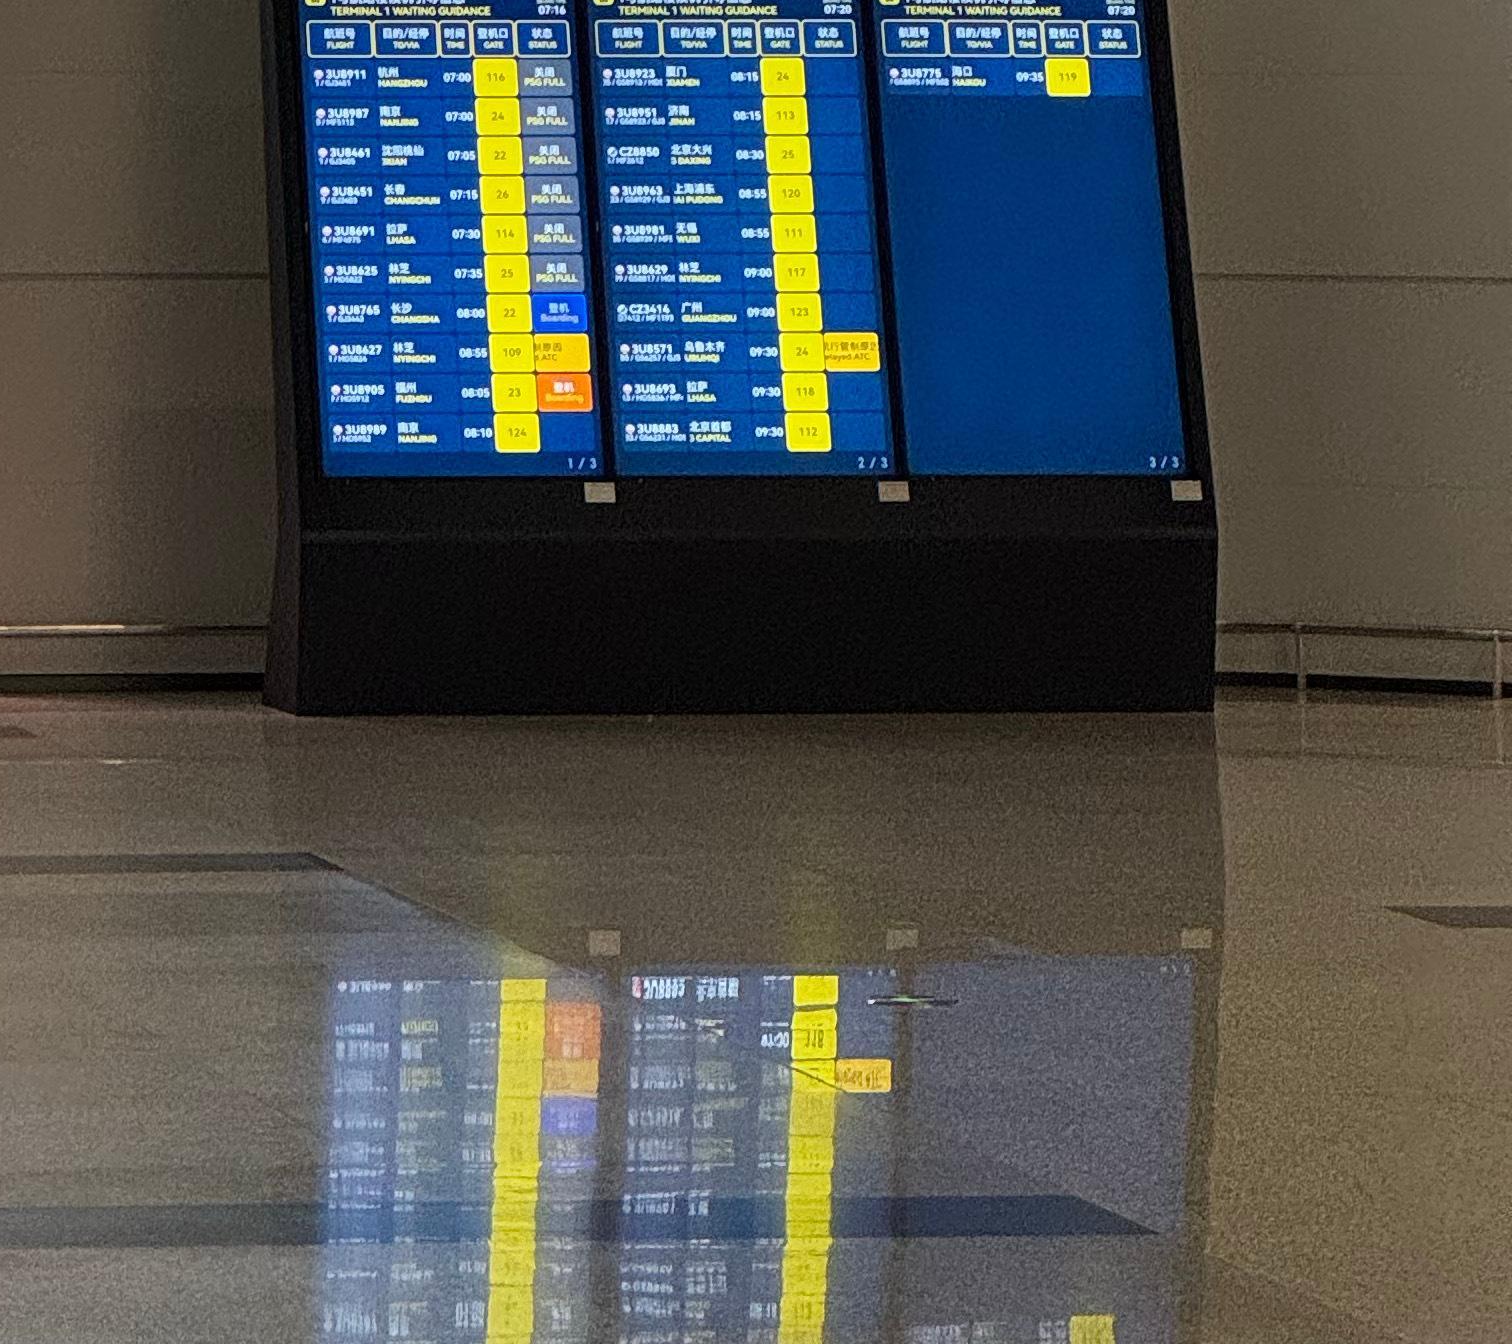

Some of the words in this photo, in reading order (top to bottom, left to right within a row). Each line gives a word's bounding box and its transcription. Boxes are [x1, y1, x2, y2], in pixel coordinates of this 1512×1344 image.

[330, 6, 382, 16] TERMINAL
[392, 6, 436, 16] WAITING
[438, 6, 491, 16] GUIDANCE
[538, 5, 566, 15] 07:16
[618, 6, 670, 15] TERMINAL
[679, 6, 723, 15] WAITING
[725, 6, 777, 15] GUIDANCE
[824, 5, 852, 15] 07:20
[904, 6, 955, 16] TERMINAL
[964, 6, 1008, 16] WAITING
[1009, 6, 1061, 16] GUIDANCE
[443, 72, 471, 83] 07:00
[487, 72, 505, 82] 116
[731, 72, 759, 82] 08:15
[1059, 72, 1077, 81] 119
[445, 111, 473, 122] 07:00
[733, 111, 761, 121] 08:15
[776, 111, 794, 120] 113
[448, 150, 476, 161] 07:05
[494, 151, 506, 160] 22
[736, 150, 764, 160] 08:30
[782, 150, 794, 159] 25
[450, 190, 478, 200] 07:15
[496, 190, 509, 199] 26
[738, 189, 767, 199] 08:55
[782, 189, 800, 198] 120
[452, 229, 480, 239] 07:30
[741, 228, 769, 238] 08:55
[784, 229, 802, 238] 111
[454, 268, 483, 279] 07:35
[501, 269, 513, 278] 25
[744, 268, 772, 278] 09:00
[787, 268, 806, 277] 117
[456, 308, 485, 318] 08:00
[503, 308, 516, 317] 22
[747, 307, 775, 318] 09:00
[790, 308, 808, 317] 123
[503, 348, 521, 357] 109
[749, 347, 778, 357] 09:30
[461, 388, 490, 398] 08:05
[508, 388, 521, 397] 23
[752, 387, 781, 397] 09:30
[796, 387, 814, 396] 118
[464, 428, 492, 438] 08:10
[755, 427, 784, 437] 09:30
[799, 427, 817, 436] 112
